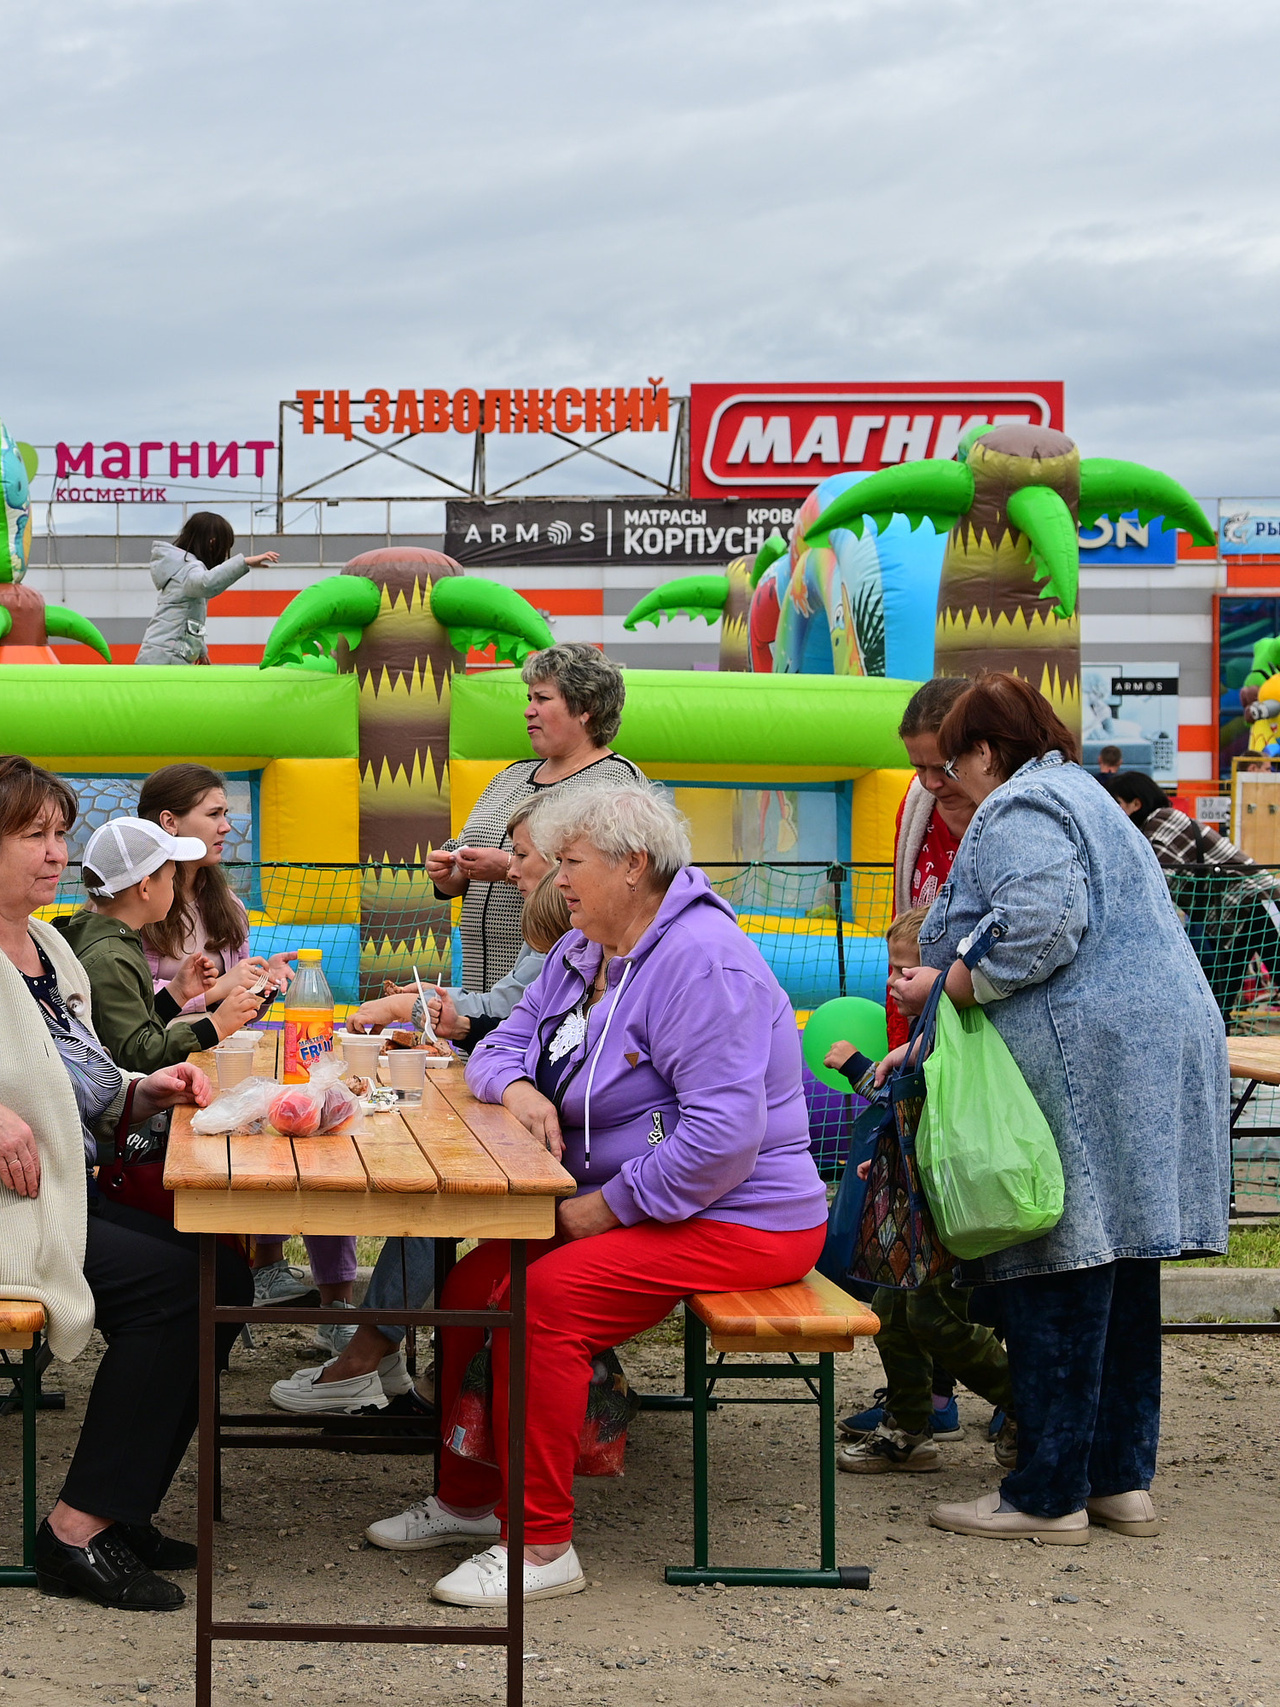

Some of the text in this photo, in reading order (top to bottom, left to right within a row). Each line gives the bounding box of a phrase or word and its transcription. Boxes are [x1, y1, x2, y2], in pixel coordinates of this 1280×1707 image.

[296, 377, 669, 441] ТЦ ЗАВОЛЖСКИЙ
[726, 415, 1031, 464] МАГНИ
[56, 441, 274, 479] магнит
[56, 487, 167, 501] косметик
[624, 509, 707, 526] МАТРАСЫ
[299, 1034, 325, 1047] MASTER
